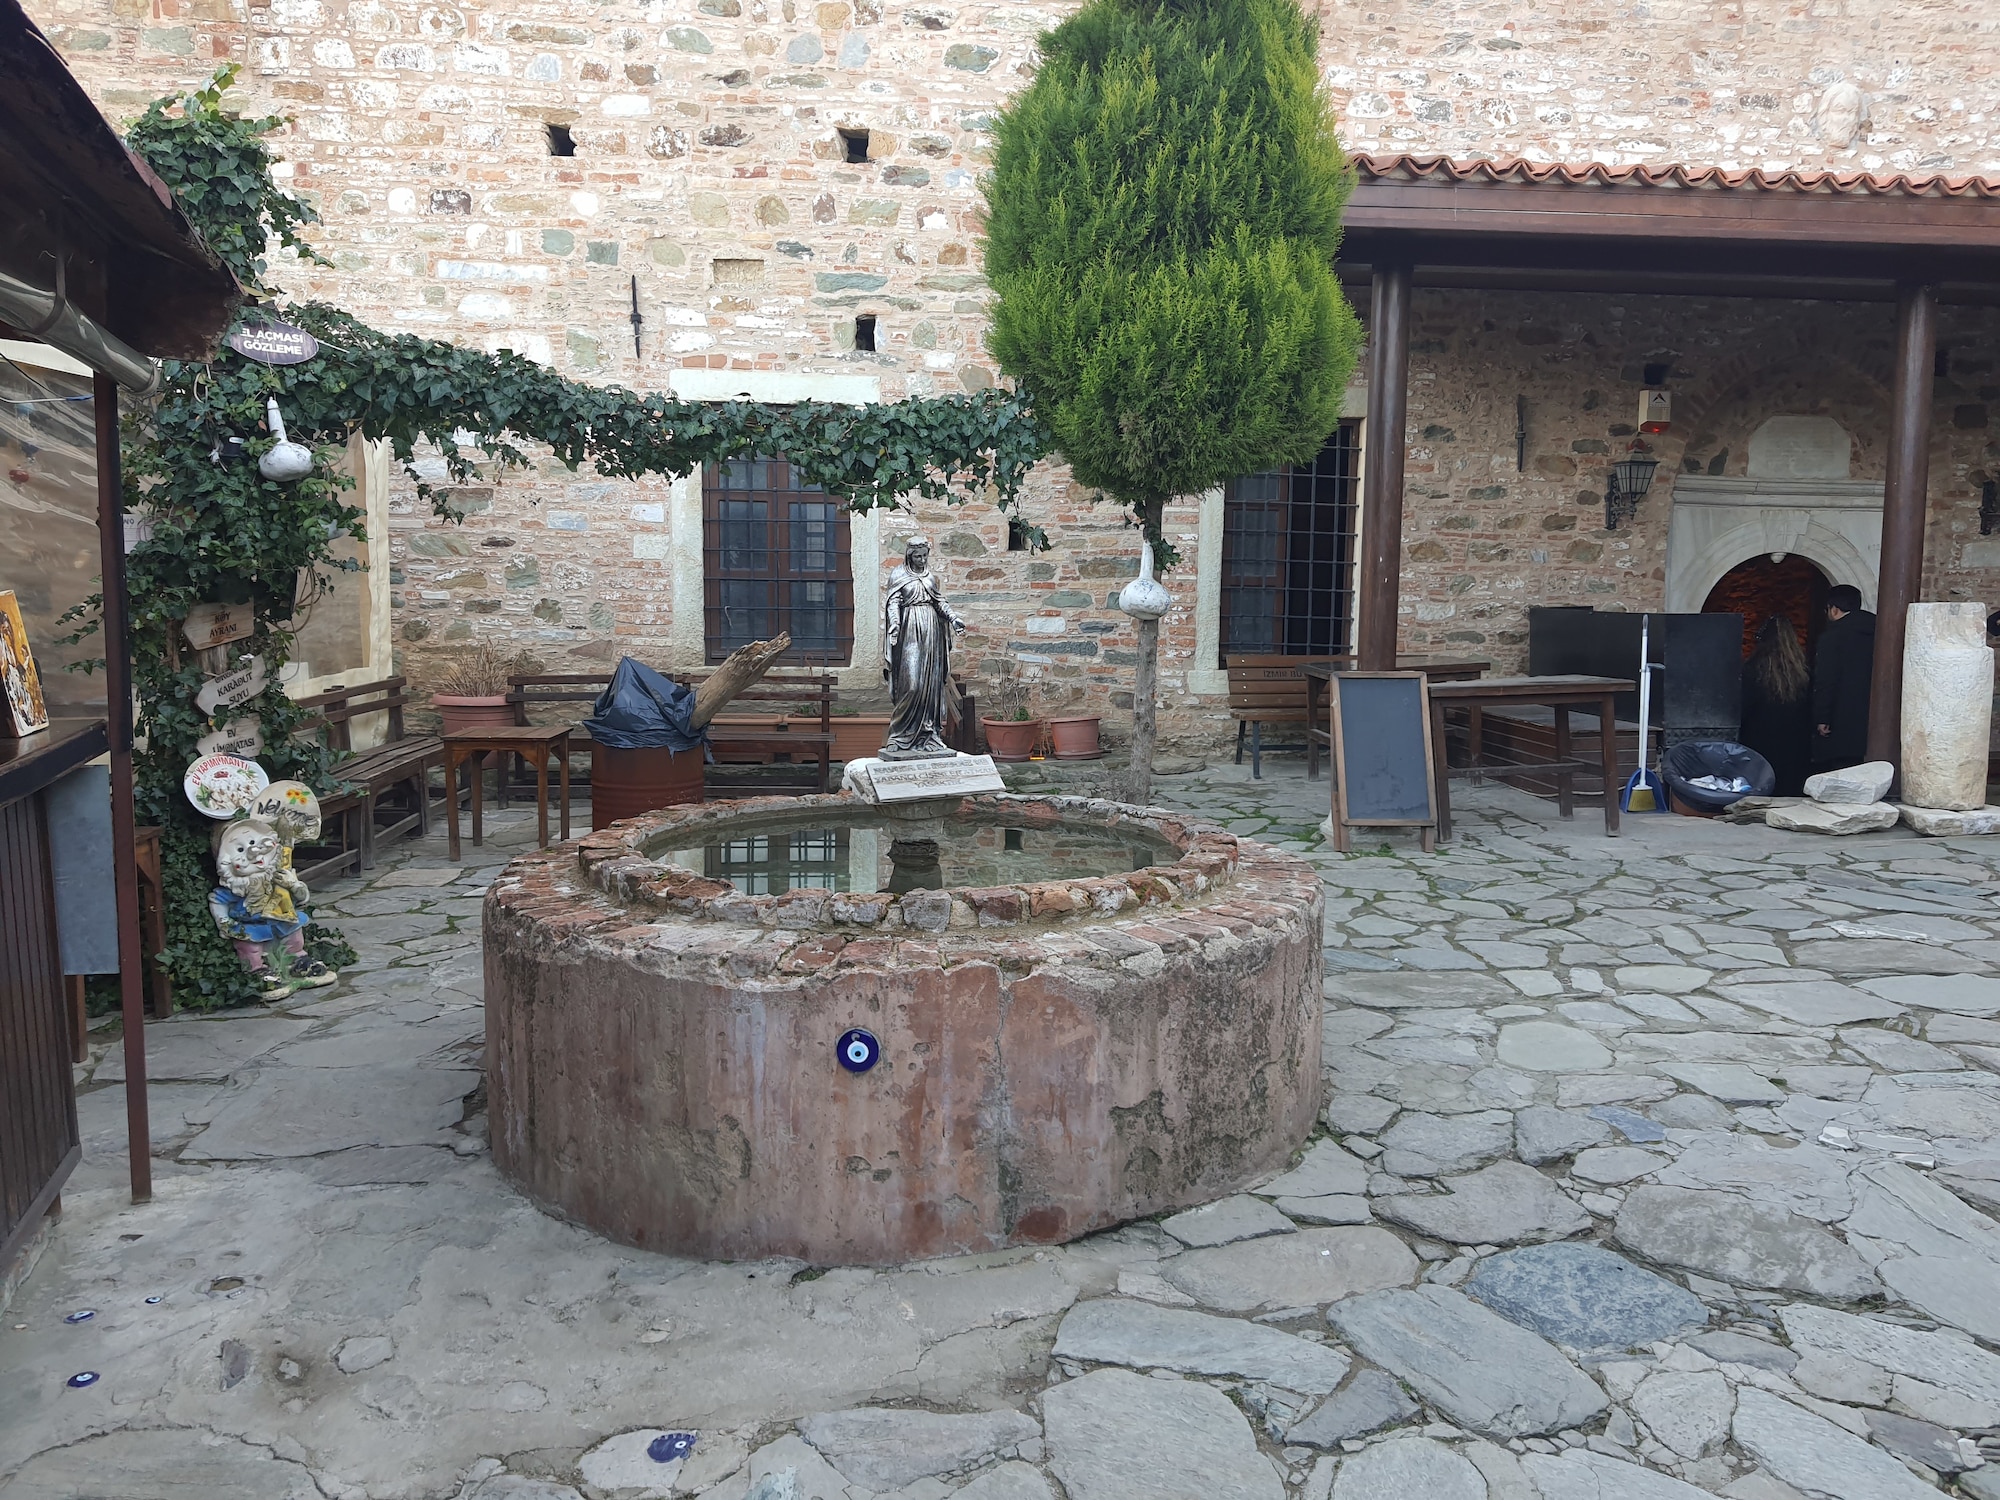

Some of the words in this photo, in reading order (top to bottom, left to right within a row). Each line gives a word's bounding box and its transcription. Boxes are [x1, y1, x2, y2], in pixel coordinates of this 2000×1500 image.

[240, 328, 254, 338] EL
[256, 330, 304, 344] AÇMASI
[243, 339, 303, 356] GÖZLEME
[209, 625, 237, 638] AYRANI
[217, 672, 253, 697] KARADUT
[229, 688, 250, 706] SUYU
[227, 729, 237, 739] EV
[196, 758, 221, 775] YAPIMI
[192, 773, 201, 786] EV
